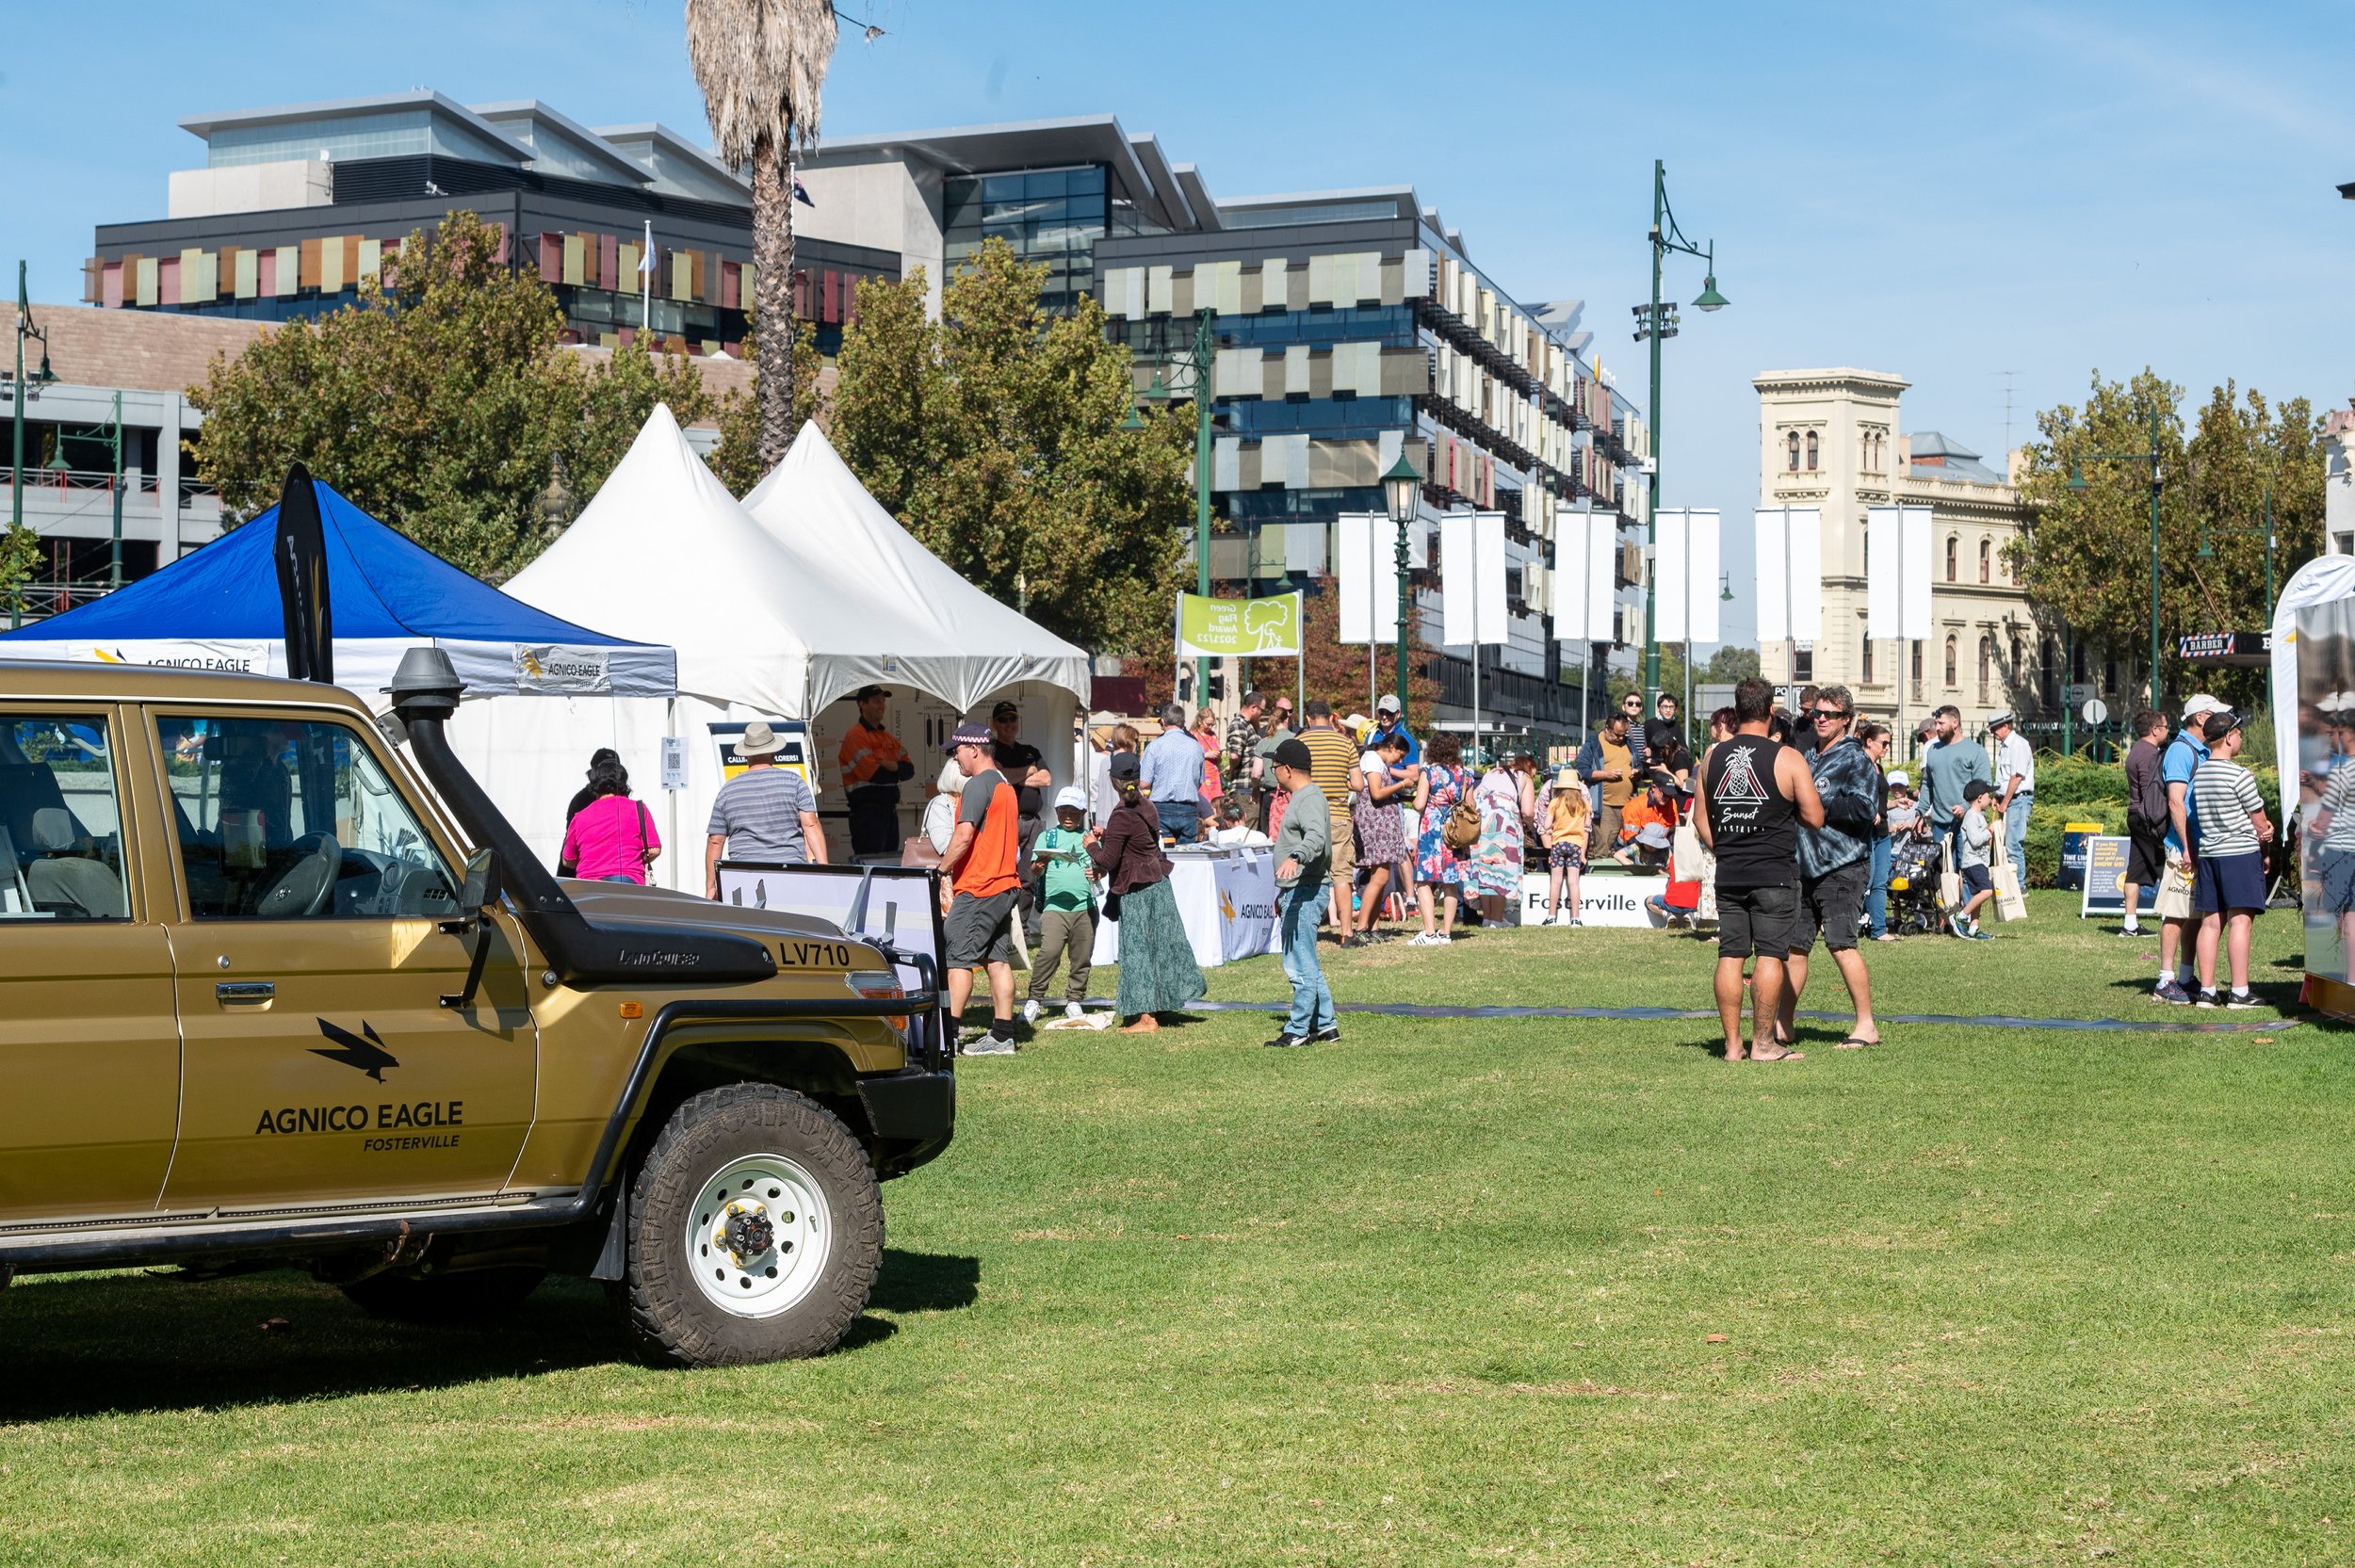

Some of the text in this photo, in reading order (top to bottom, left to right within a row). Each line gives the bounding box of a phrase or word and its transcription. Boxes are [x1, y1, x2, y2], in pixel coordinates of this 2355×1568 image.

[2190, 639, 2223, 651] BARBER
[205, 658, 251, 672] EAGLE
[548, 663, 601, 677] AGNICO EAGLE
[773, 754, 799, 763] LORERS!
[1721, 806, 1759, 823] Sunset
[2167, 886, 2190, 896] AGNICO
[1241, 904, 1263, 919] AGNICO
[780, 943, 850, 966] LV710
[255, 1101, 463, 1135] AGNICO EAGLE
[364, 1135, 461, 1152] FOSTERVILLE
